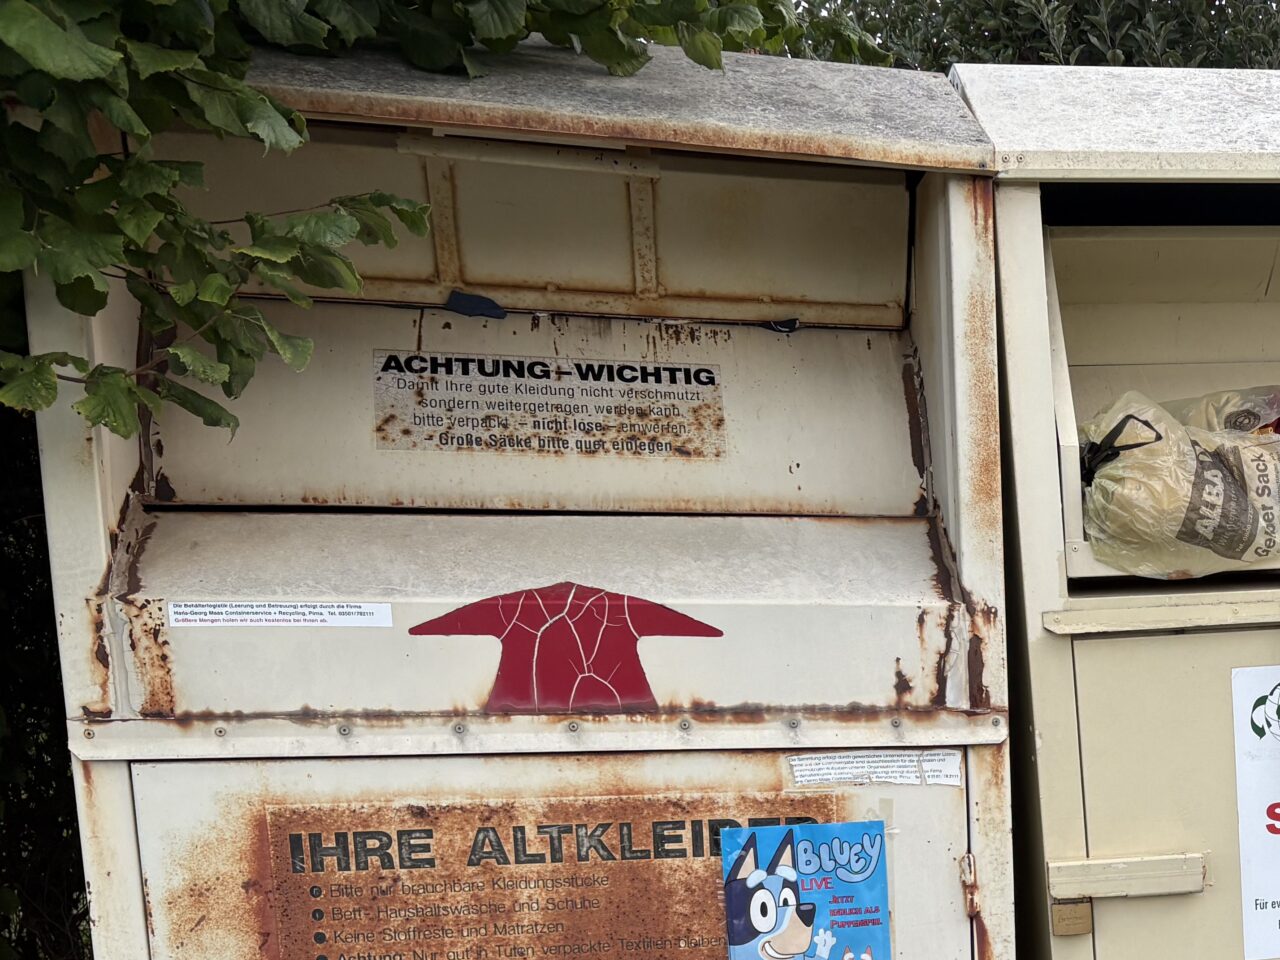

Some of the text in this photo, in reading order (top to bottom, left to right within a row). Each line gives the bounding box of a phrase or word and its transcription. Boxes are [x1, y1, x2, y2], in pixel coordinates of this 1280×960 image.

[397, 378, 440, 391] Damit
[445, 380, 473, 393] Ihre
[478, 383, 509, 397] gute
[515, 384, 575, 399] Kleidung
[580, 387, 614, 400] nicht
[421, 397, 645, 417] sondern weitergetragen werden
[413, 409, 444, 427] bitte
[533, 415, 568, 431] nicht
[573, 421, 603, 432] lose
[439, 432, 483, 447] Große
[488, 434, 532, 449] Säcke
[537, 437, 570, 450] bitte
[576, 440, 607, 456] quer
[1250, 452, 1272, 498] Sack
[289, 828, 435, 874] IHRE
[796, 832, 883, 884] BLUEY
[330, 879, 486, 898] Bitte nur brauchbare
[800, 876, 834, 892] LIVE
[514, 898, 539, 913] und
[546, 897, 600, 911] Schuhe
[1255, 898, 1269, 911] Für
[334, 921, 564, 943] Keine Stoffreste und Matratzen
[541, 940, 611, 956] verpackte
[619, 936, 671, 951] Textilien
